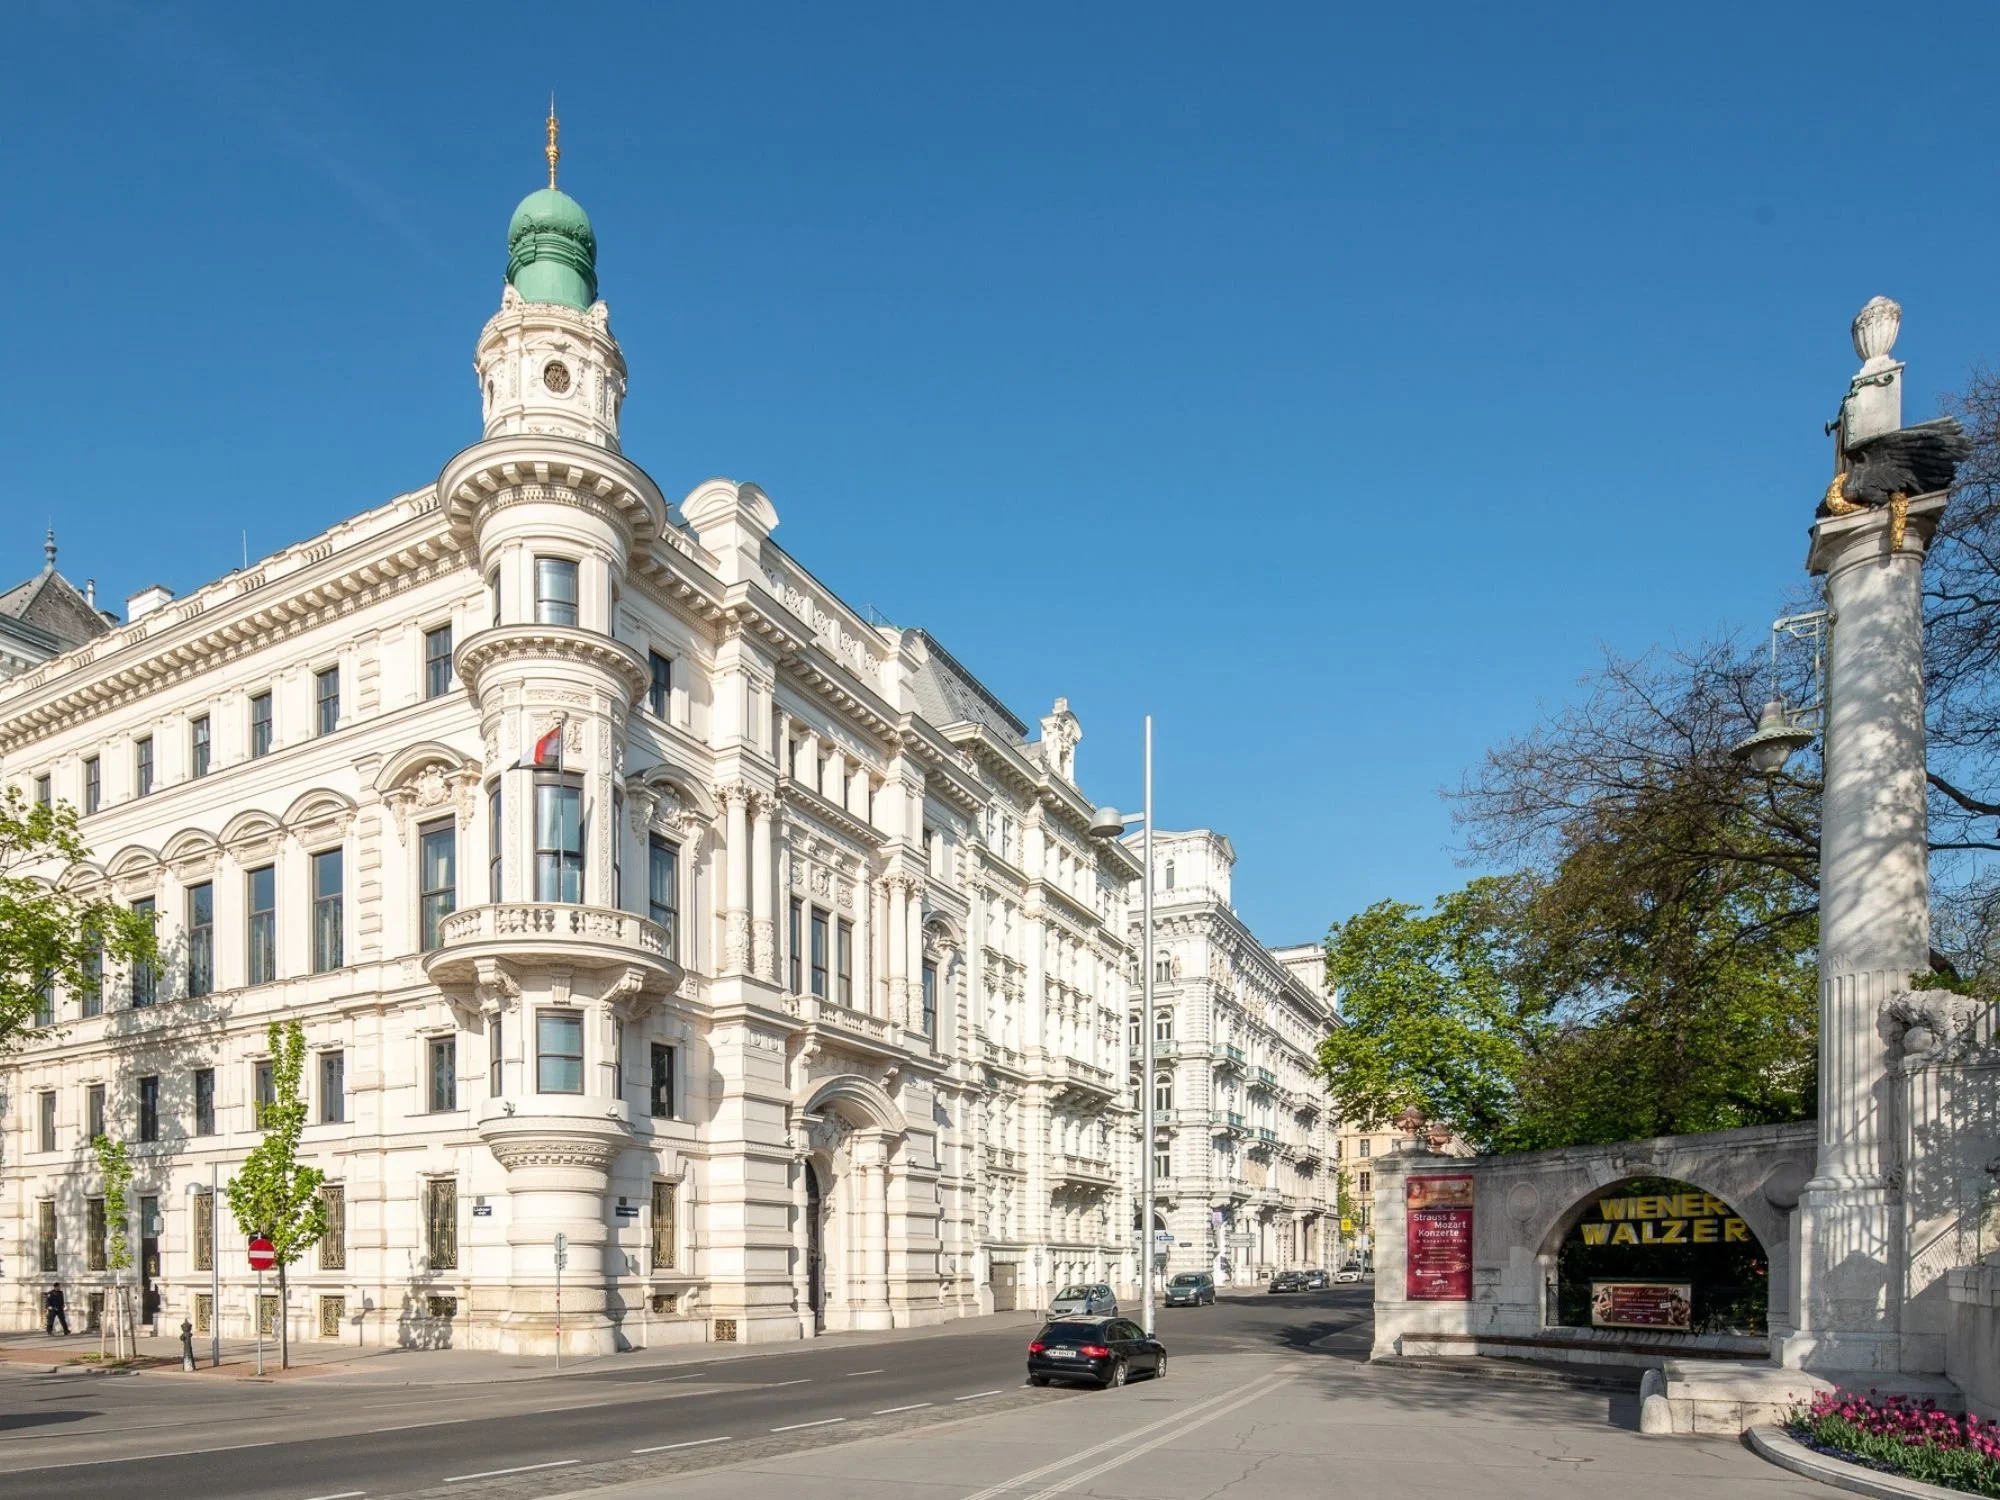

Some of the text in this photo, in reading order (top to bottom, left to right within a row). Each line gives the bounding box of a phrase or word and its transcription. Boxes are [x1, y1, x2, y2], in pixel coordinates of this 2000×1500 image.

[1600, 1193, 1728, 1220] WIENER
[1413, 1212, 1456, 1221] Strauss &
[1434, 1220, 1466, 1229] Mozart
[1418, 1229, 1460, 1238] Konzerte
[1581, 1217, 1749, 1245] WALZER
